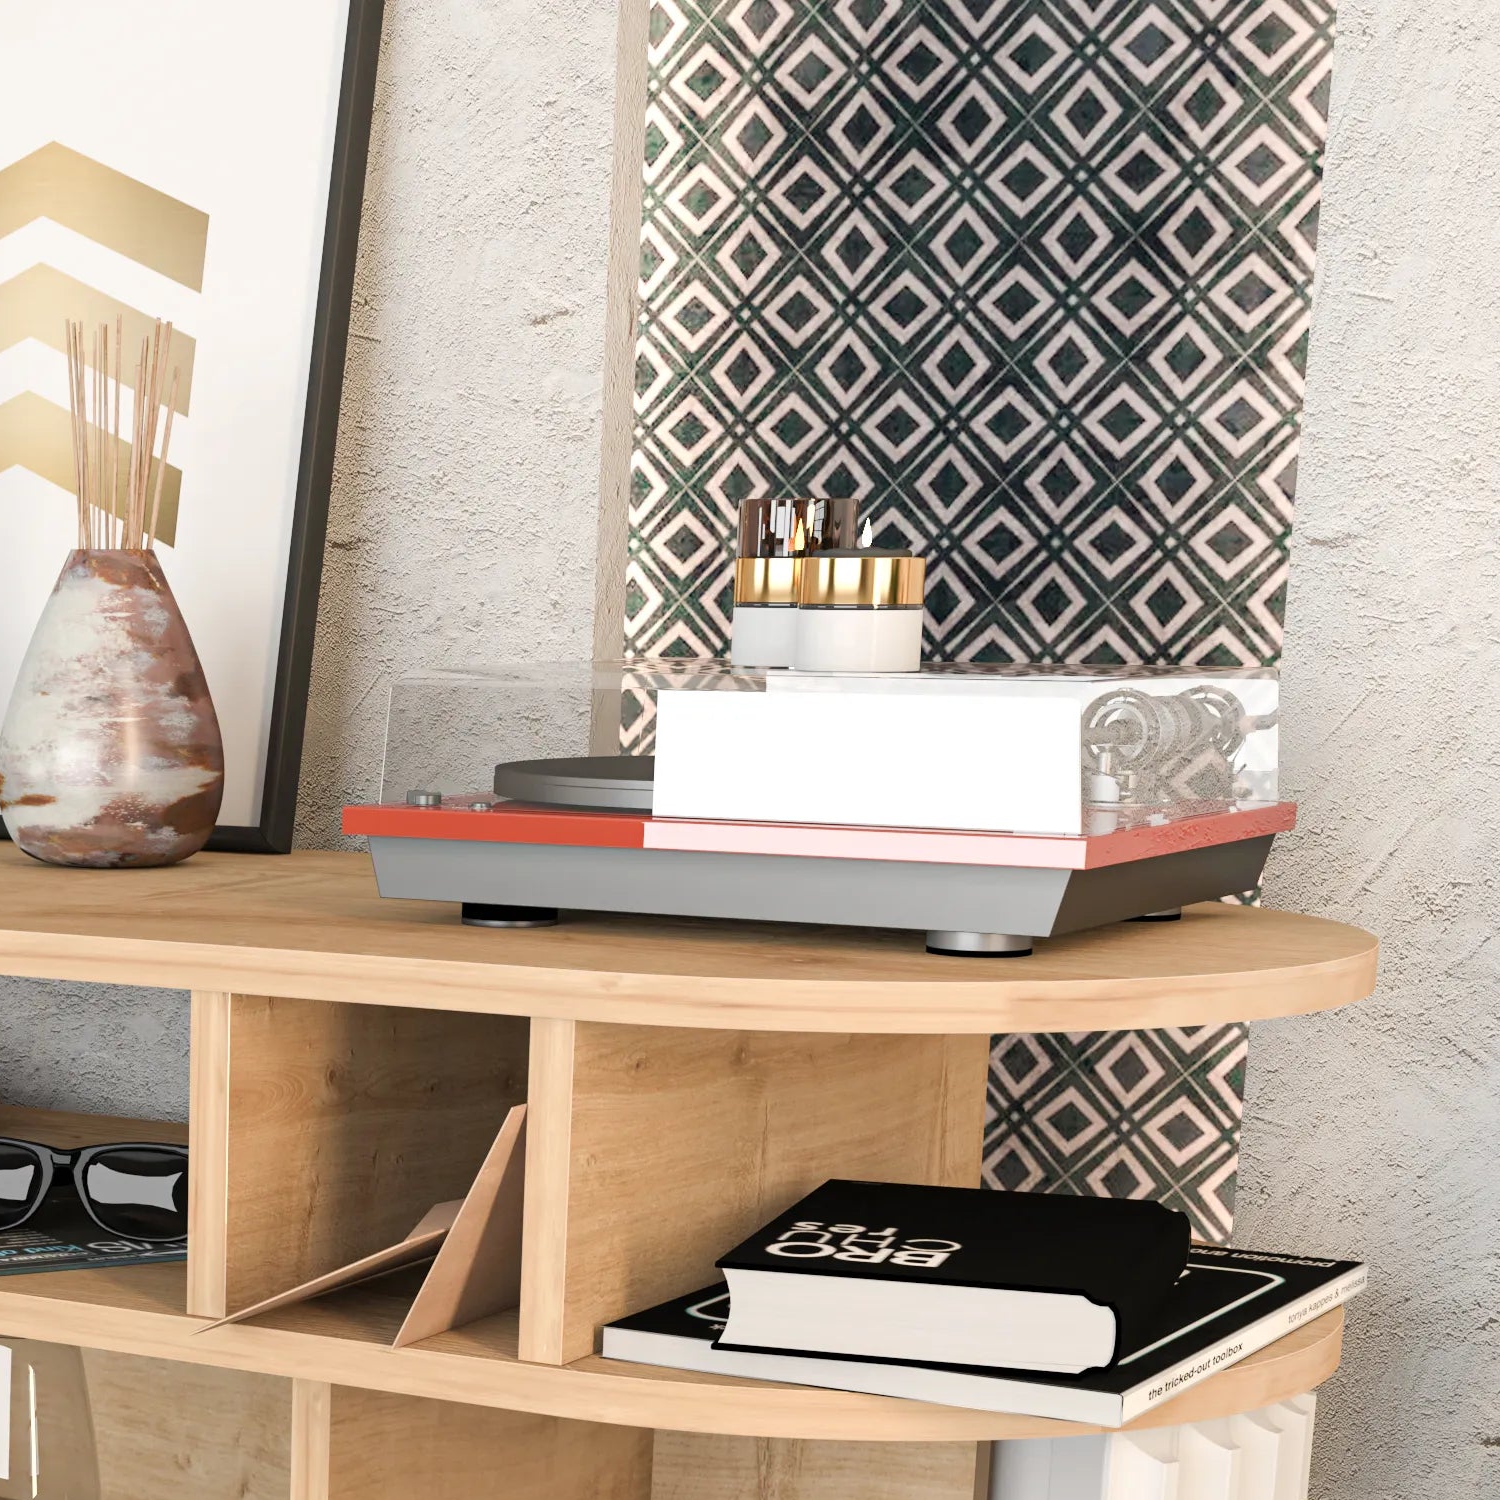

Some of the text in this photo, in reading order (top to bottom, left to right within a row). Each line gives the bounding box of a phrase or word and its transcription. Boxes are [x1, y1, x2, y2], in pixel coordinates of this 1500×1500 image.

[791, 1221, 898, 1236] res
[23, 1243, 85, 1254] Kind
[776, 1230, 963, 1251] CHU
[765, 1241, 951, 1268] BRO
[1231, 1252, 1336, 1268] promotion
[1288, 1276, 1366, 1325] tonya kappes & melissa
[1148, 1342, 1244, 1401] the tricked-out toolbox
